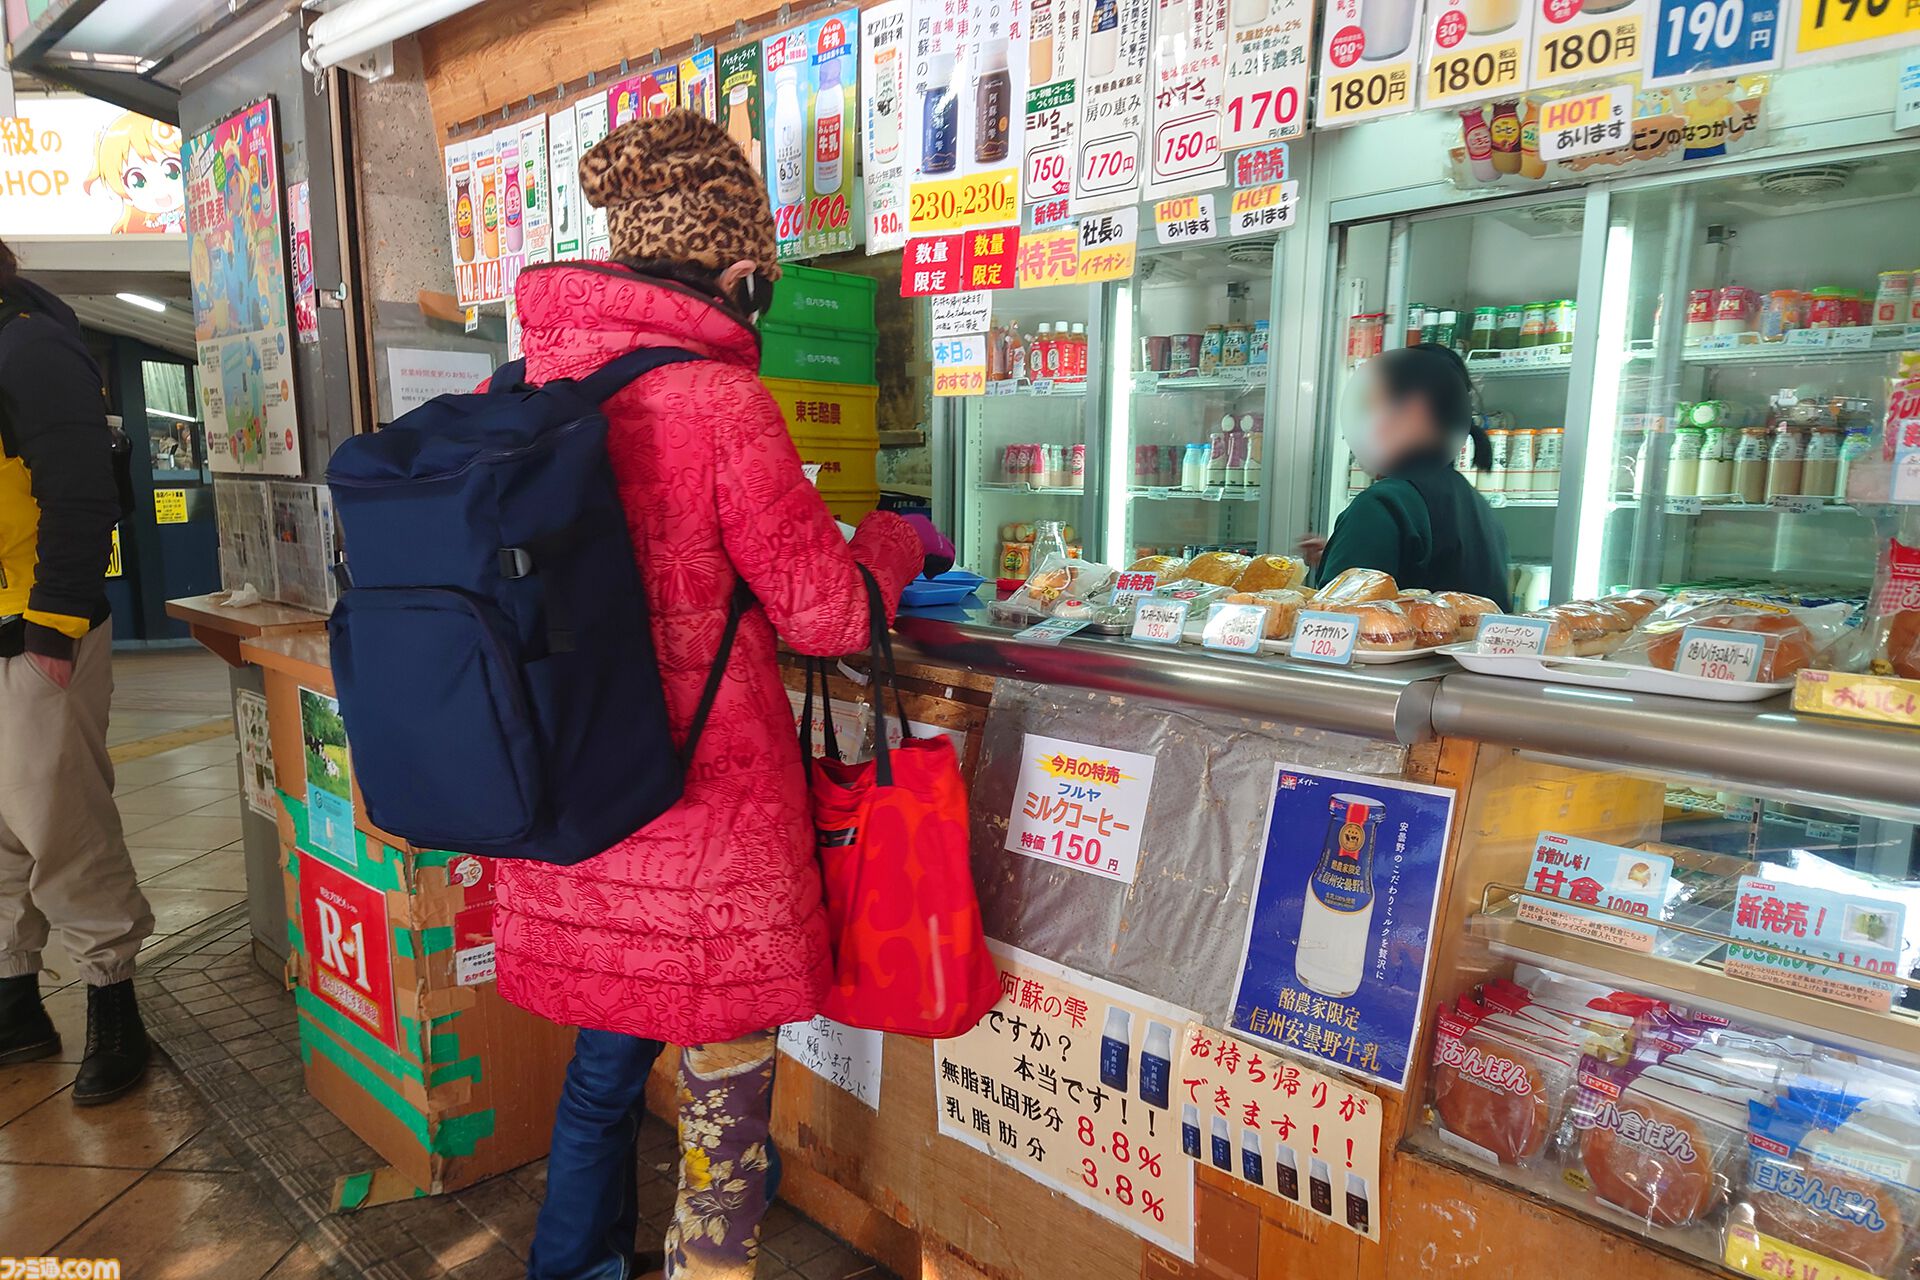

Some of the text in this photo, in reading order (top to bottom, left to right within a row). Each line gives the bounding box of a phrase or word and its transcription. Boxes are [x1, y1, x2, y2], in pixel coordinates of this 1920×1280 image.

[823, 32, 840, 49] 牛乳
[1439, 22, 1465, 38] 30%
[1333, 42, 1364, 58] 100%
[1544, 28, 1636, 73] 180円
[729, 63, 748, 74] コーヒー
[1433, 52, 1517, 93] 180円
[1330, 73, 1406, 112] 180円
[1025, 109, 1061, 131] ミルク
[1227, 86, 1298, 133] 170
[1548, 96, 1623, 129] HOT も
[1495, 124, 1517, 135] コーヒー
[1556, 119, 1625, 150] あります
[1164, 131, 1218, 164] 150円
[1087, 150, 1134, 181] 170円
[1236, 147, 1284, 182] 新発売
[806, 194, 850, 231] 190円
[963, 181, 1015, 216] 230円
[1159, 197, 1195, 219] HOT
[1235, 186, 1278, 210] HOT
[1082, 216, 1124, 247] 社長の
[1167, 217, 1210, 239] あります
[1241, 205, 1290, 229] あります
[915, 241, 949, 264] 数量
[974, 232, 1005, 256] 数量
[1019, 238, 1078, 282] 特売
[913, 270, 947, 292] 限定
[971, 264, 1003, 287] 限定
[1718, 299, 1740, 313] R-1
[935, 341, 973, 364] 本日の
[937, 371, 984, 391] おすすめ
[795, 400, 842, 425] 東毛酪農
[1116, 574, 1157, 592] 新発売
[1222, 634, 1245, 647] 130円
[1487, 626, 1535, 637] ハンバーグパン
[1310, 640, 1337, 657] 120円
[1051, 755, 1121, 785] 今月の特売
[1297, 778, 1320, 787] メイトー
[1057, 782, 1102, 802] フルヤ
[1022, 791, 1130, 837] ミルクコーヒー
[1020, 830, 1119, 872] 特価 150 円
[1533, 866, 1604, 906] 甘食
[1375, 821, 1410, 981] 安曇野のこだわりミルクを贅沢に
[1607, 895, 1649, 918] 100円
[1736, 893, 1828, 938] 新発売！
[315, 897, 373, 993] R-1
[999, 971, 1090, 1029] 阿蘇の雫
[1278, 987, 1361, 1033] 酪農家限定
[1249, 1006, 1382, 1072] 信州安曇野牛乳
[1190, 1029, 1370, 1123] お持ち帰りが
[1443, 1040, 1532, 1097] あんぱん
[831, 1071, 867, 1099] スタンド
[1587, 1076, 1620, 1096] ヤマザキ
[941, 1057, 1163, 1179] 無脂乳固形分 8.8%
[1594, 1102, 1697, 1163] 小倉ぱん
[946, 1097, 1166, 1223] 乳脂肪分 3.8%
[1753, 1136, 1787, 1156] ヤマザキ
